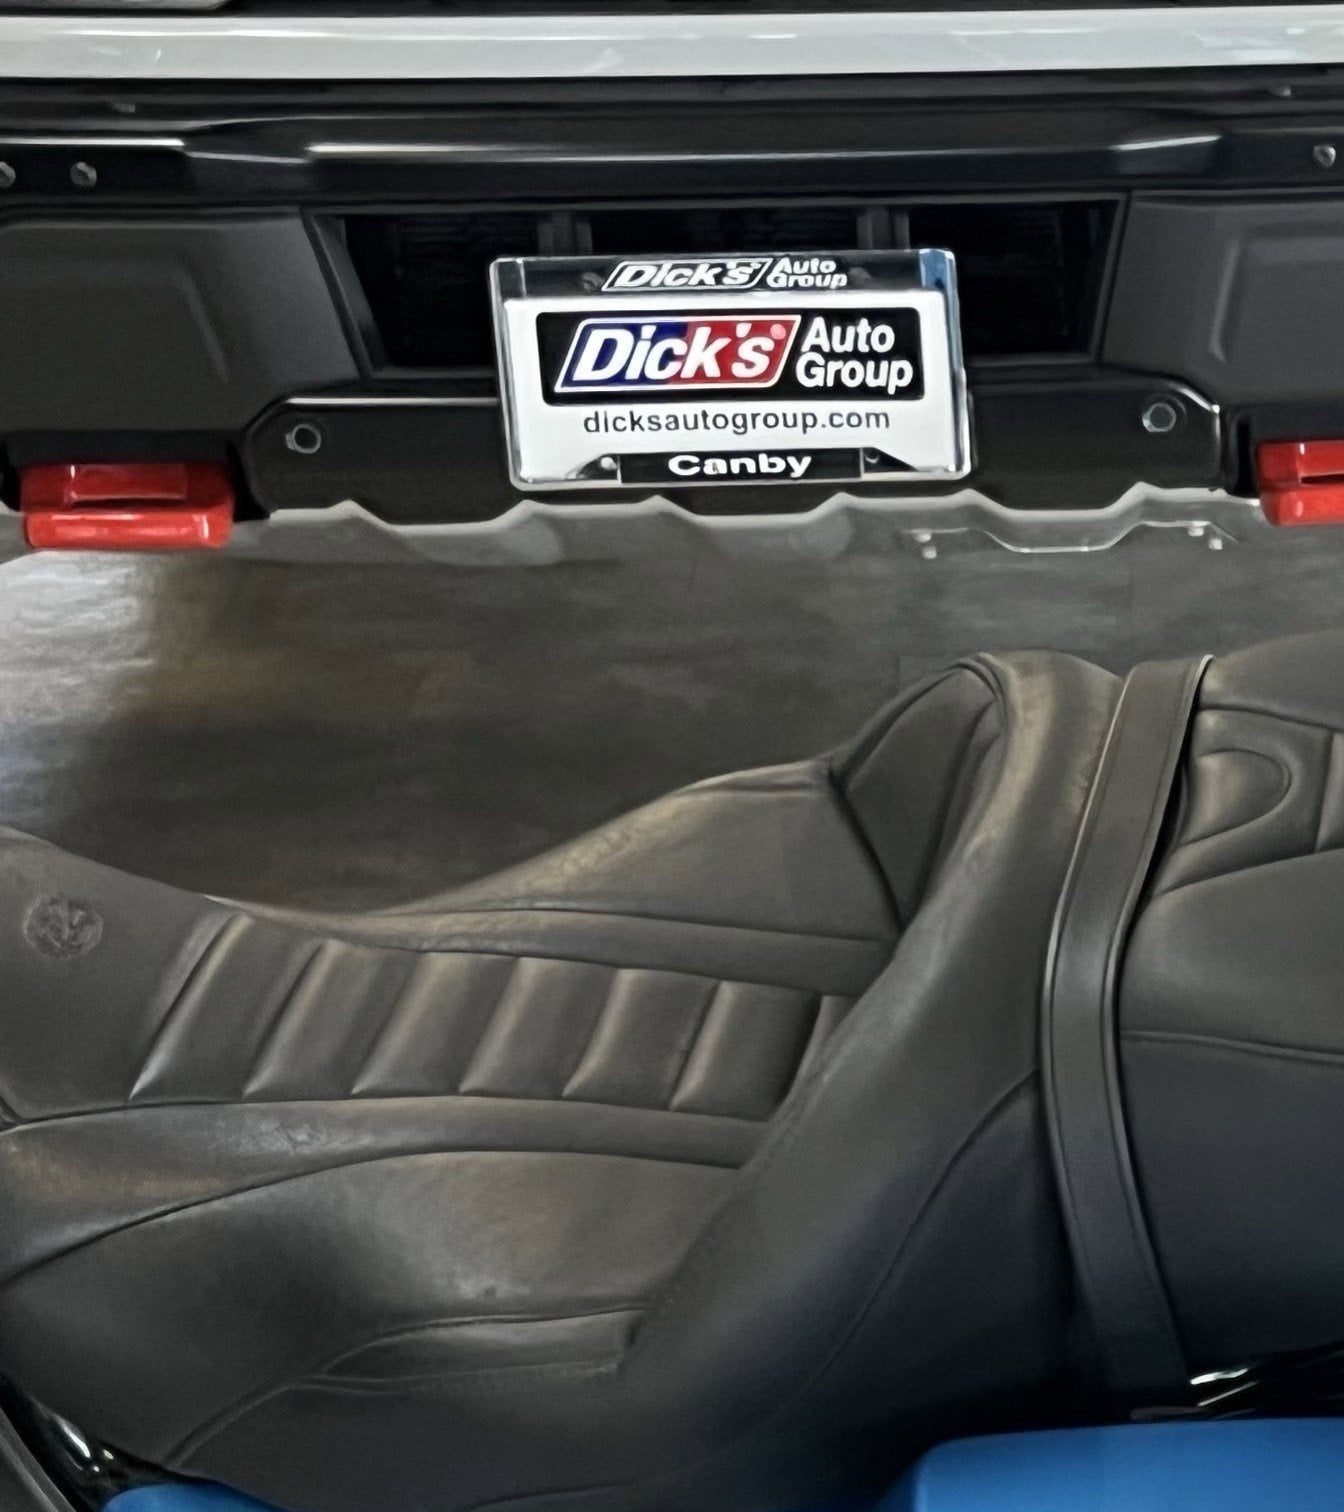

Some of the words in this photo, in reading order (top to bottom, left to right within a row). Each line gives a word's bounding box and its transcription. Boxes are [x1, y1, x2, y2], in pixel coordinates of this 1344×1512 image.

[613, 261, 752, 287] Dick's
[772, 257, 837, 274] Auto
[766, 272, 848, 289] Group
[801, 316, 896, 353] Auto
[571, 322, 774, 381] Dick's
[796, 353, 914, 395] Group
[583, 409, 891, 435] dicksautogroup.com
[667, 453, 812, 478] Canby
